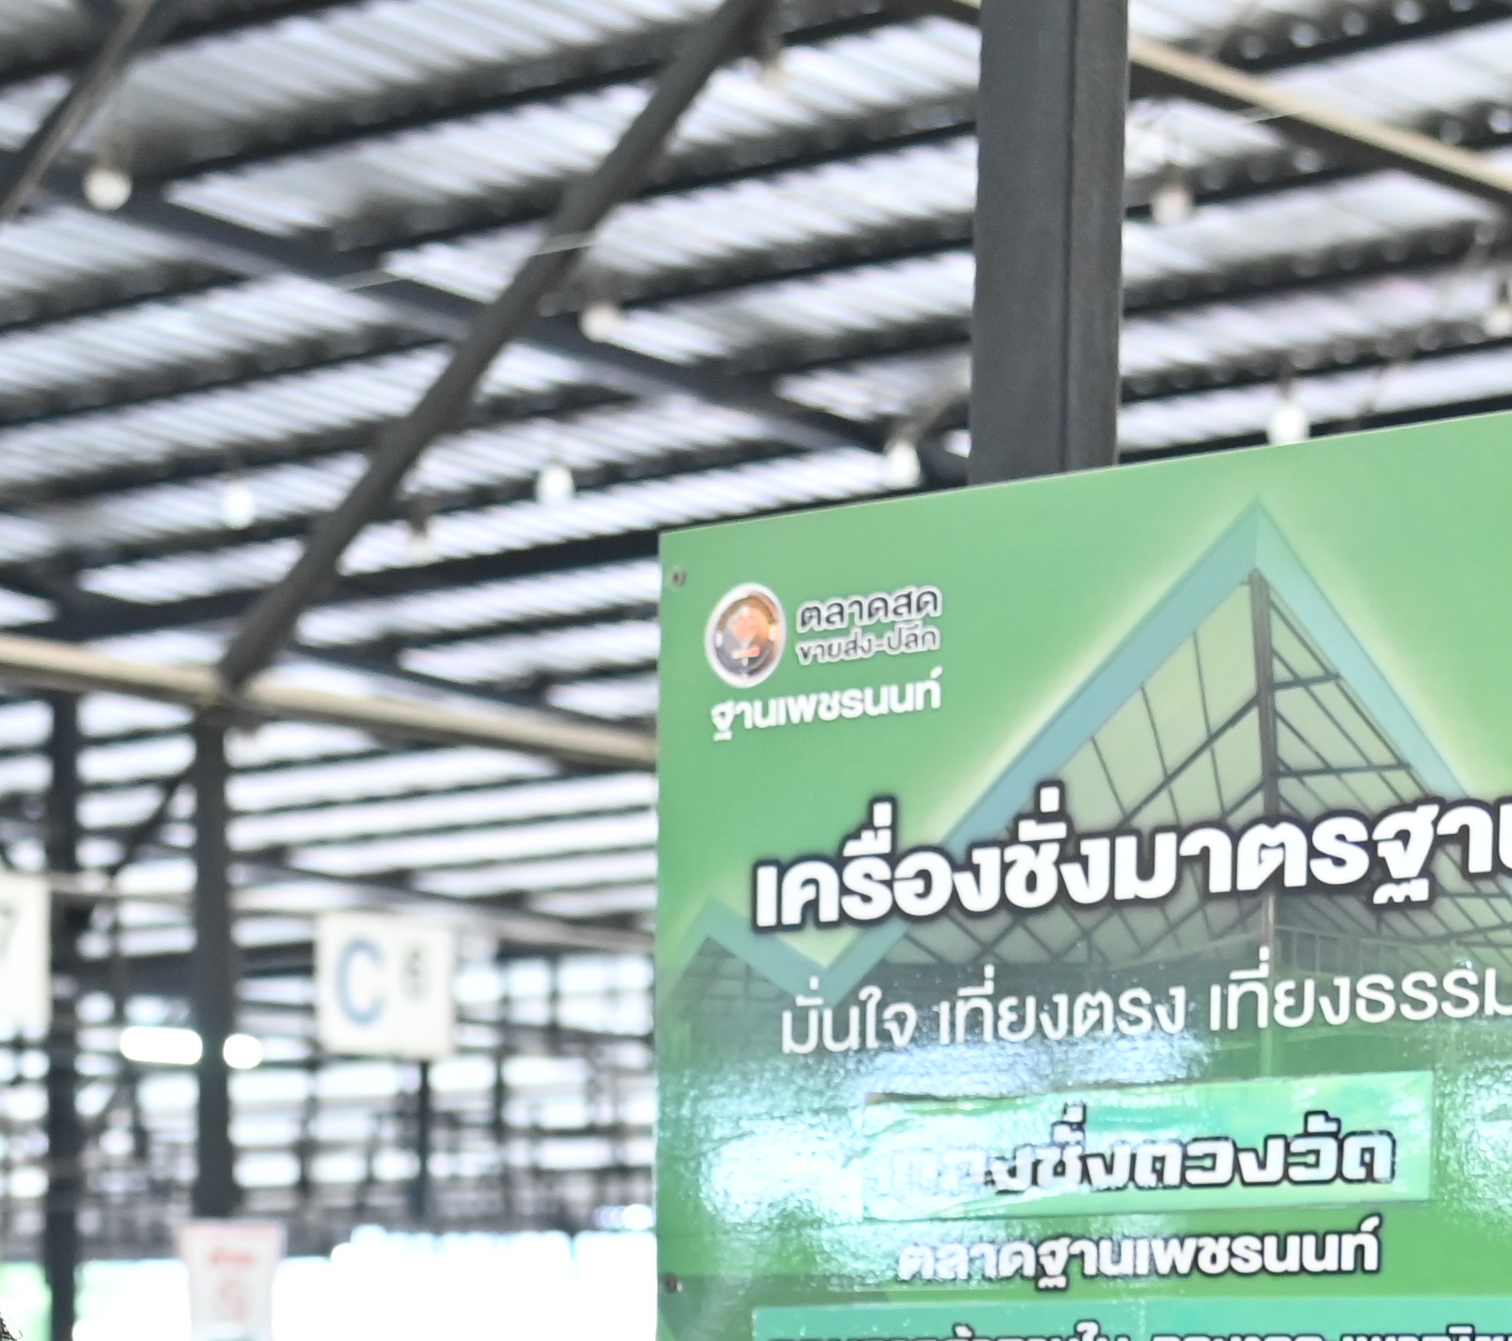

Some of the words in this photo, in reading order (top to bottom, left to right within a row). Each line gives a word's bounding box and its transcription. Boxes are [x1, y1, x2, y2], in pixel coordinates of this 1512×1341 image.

[798, 620, 939, 663] ขายส่ง-ปลีก
[799, 587, 941, 630] ตลาดสด
[711, 665, 943, 741] ฐานเพชรนนท์
[335, 936, 385, 1027] C
[781, 976, 916, 1057] มั่นใจ
[937, 965, 1188, 1044] เที่ยงตรง
[897, 1216, 1383, 1290] ตลาดฐานเพชรนนท์
